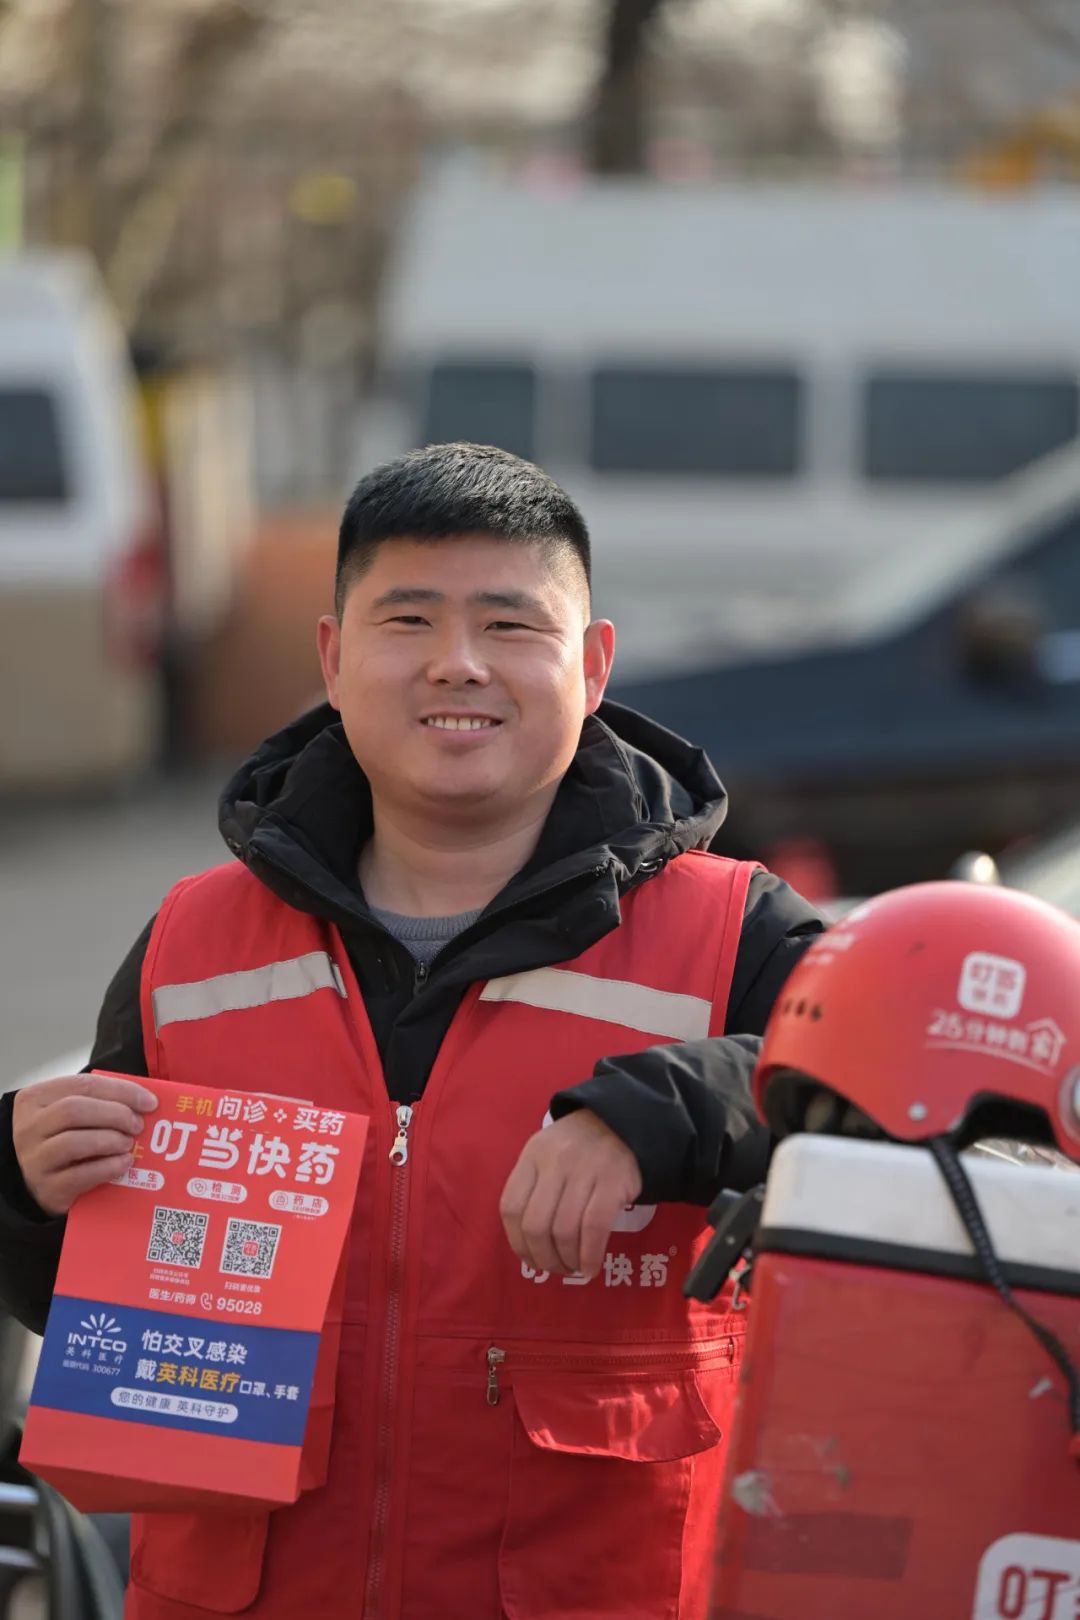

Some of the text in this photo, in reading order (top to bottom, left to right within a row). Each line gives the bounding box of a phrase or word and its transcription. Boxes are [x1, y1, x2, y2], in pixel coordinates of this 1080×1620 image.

[176, 1096, 346, 1136] 手机问诊 买药
[150, 1119, 340, 1185] 叮当快药
[293, 1195, 323, 1209] 药店
[216, 1296, 263, 1315] 95028
[67, 1332, 128, 1354] INTCO
[141, 1328, 249, 1366] 怕交叉感染
[93, 1363, 121, 1377] 300677
[117, 1390, 230, 1419] 您的健康 英科守护
